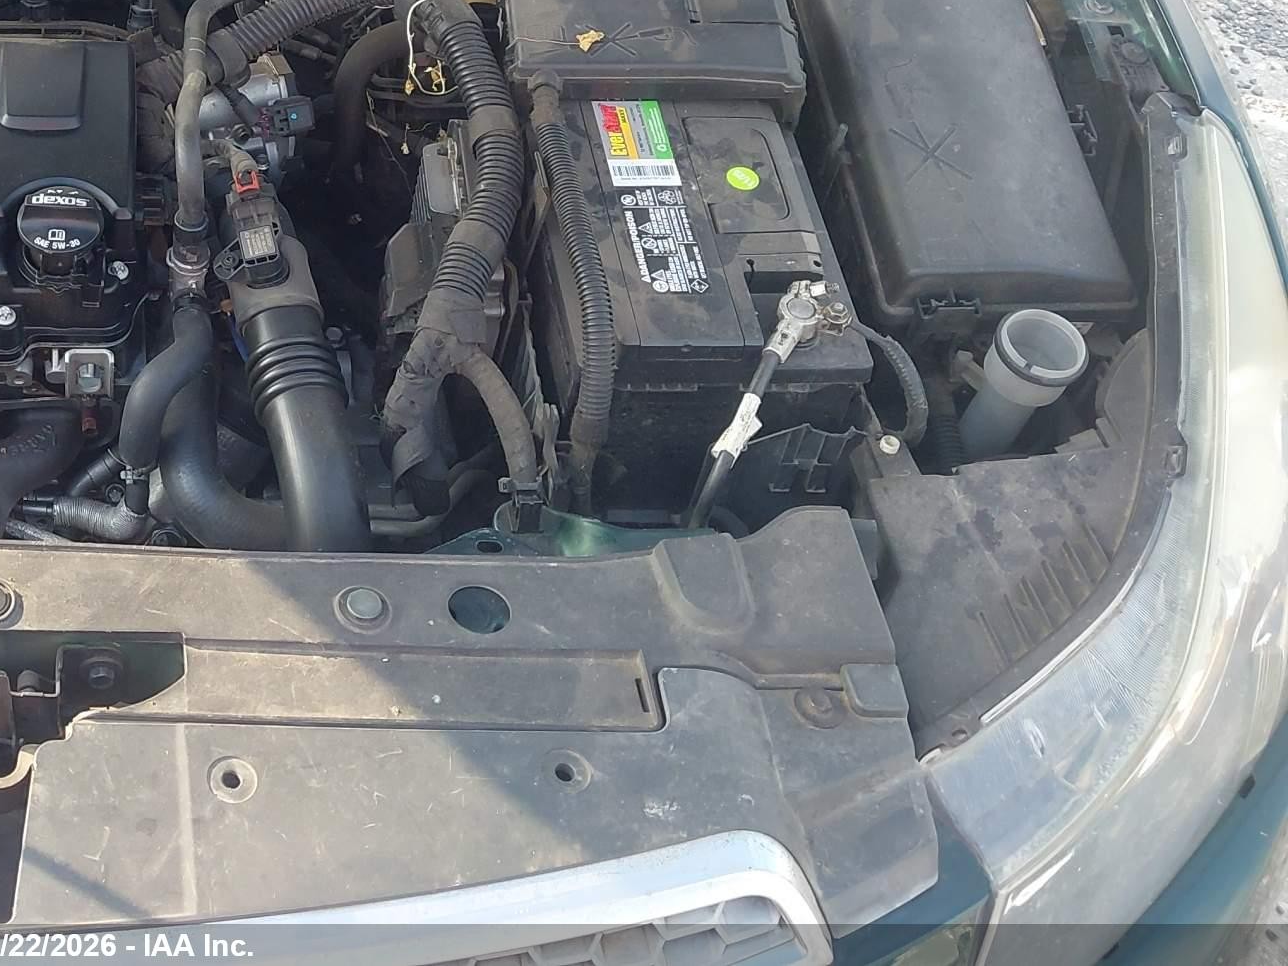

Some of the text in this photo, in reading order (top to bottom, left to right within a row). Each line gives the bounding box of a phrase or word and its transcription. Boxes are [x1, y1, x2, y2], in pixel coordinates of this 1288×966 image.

[31, 193, 89, 207] dexos
[34, 236, 81, 250] SAE 5W-30
[624, 210, 650, 275] DANGER/POISON
